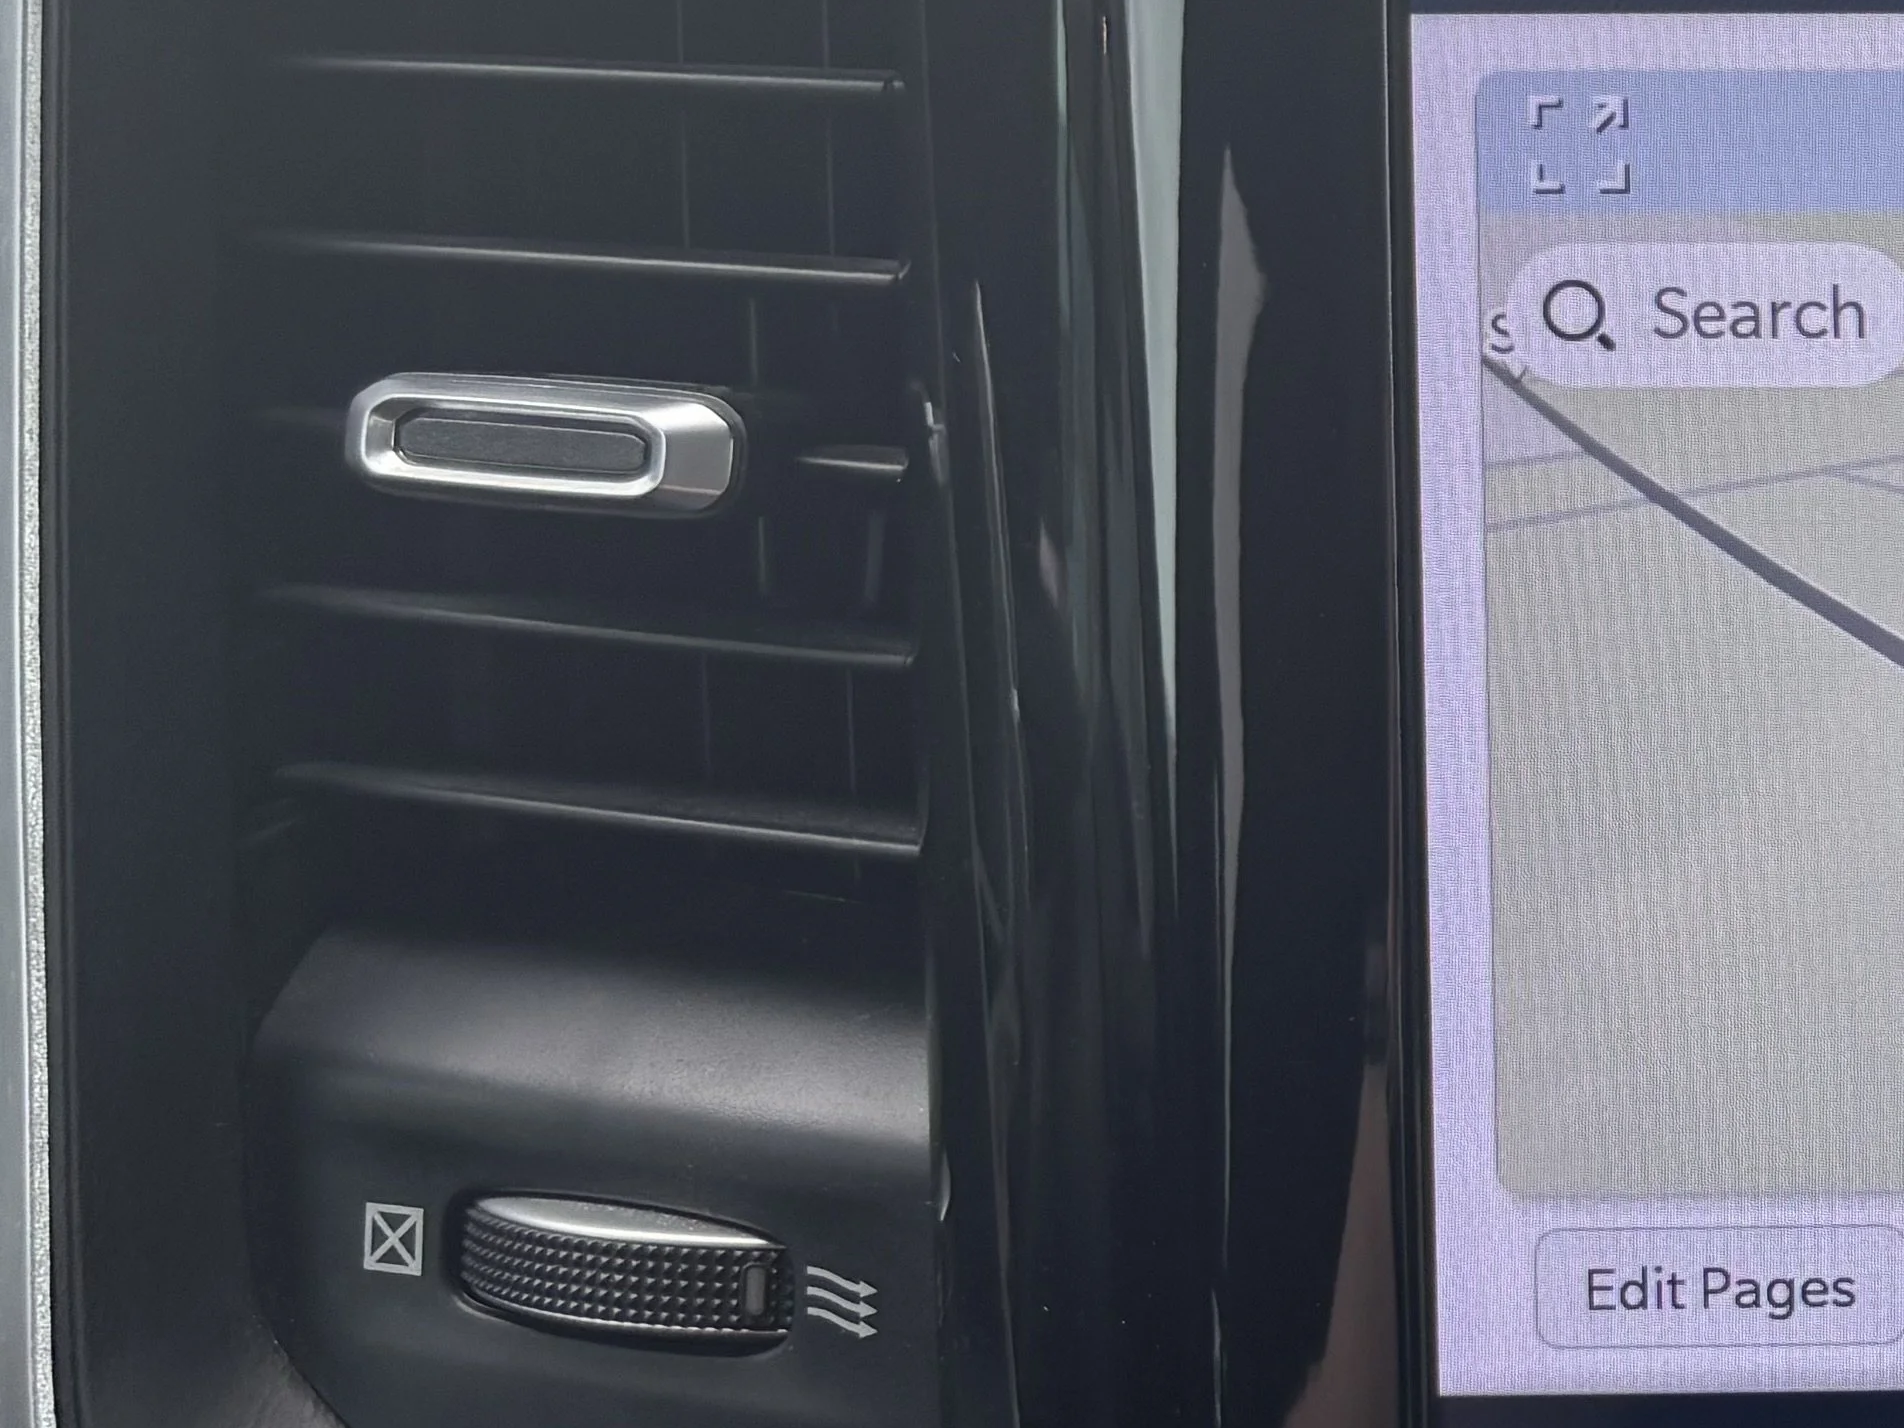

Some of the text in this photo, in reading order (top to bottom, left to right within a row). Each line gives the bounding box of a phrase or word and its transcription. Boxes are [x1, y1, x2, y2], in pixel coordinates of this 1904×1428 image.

[1652, 285, 1866, 341] Search
[1587, 1267, 1856, 1321] Edit Pages
